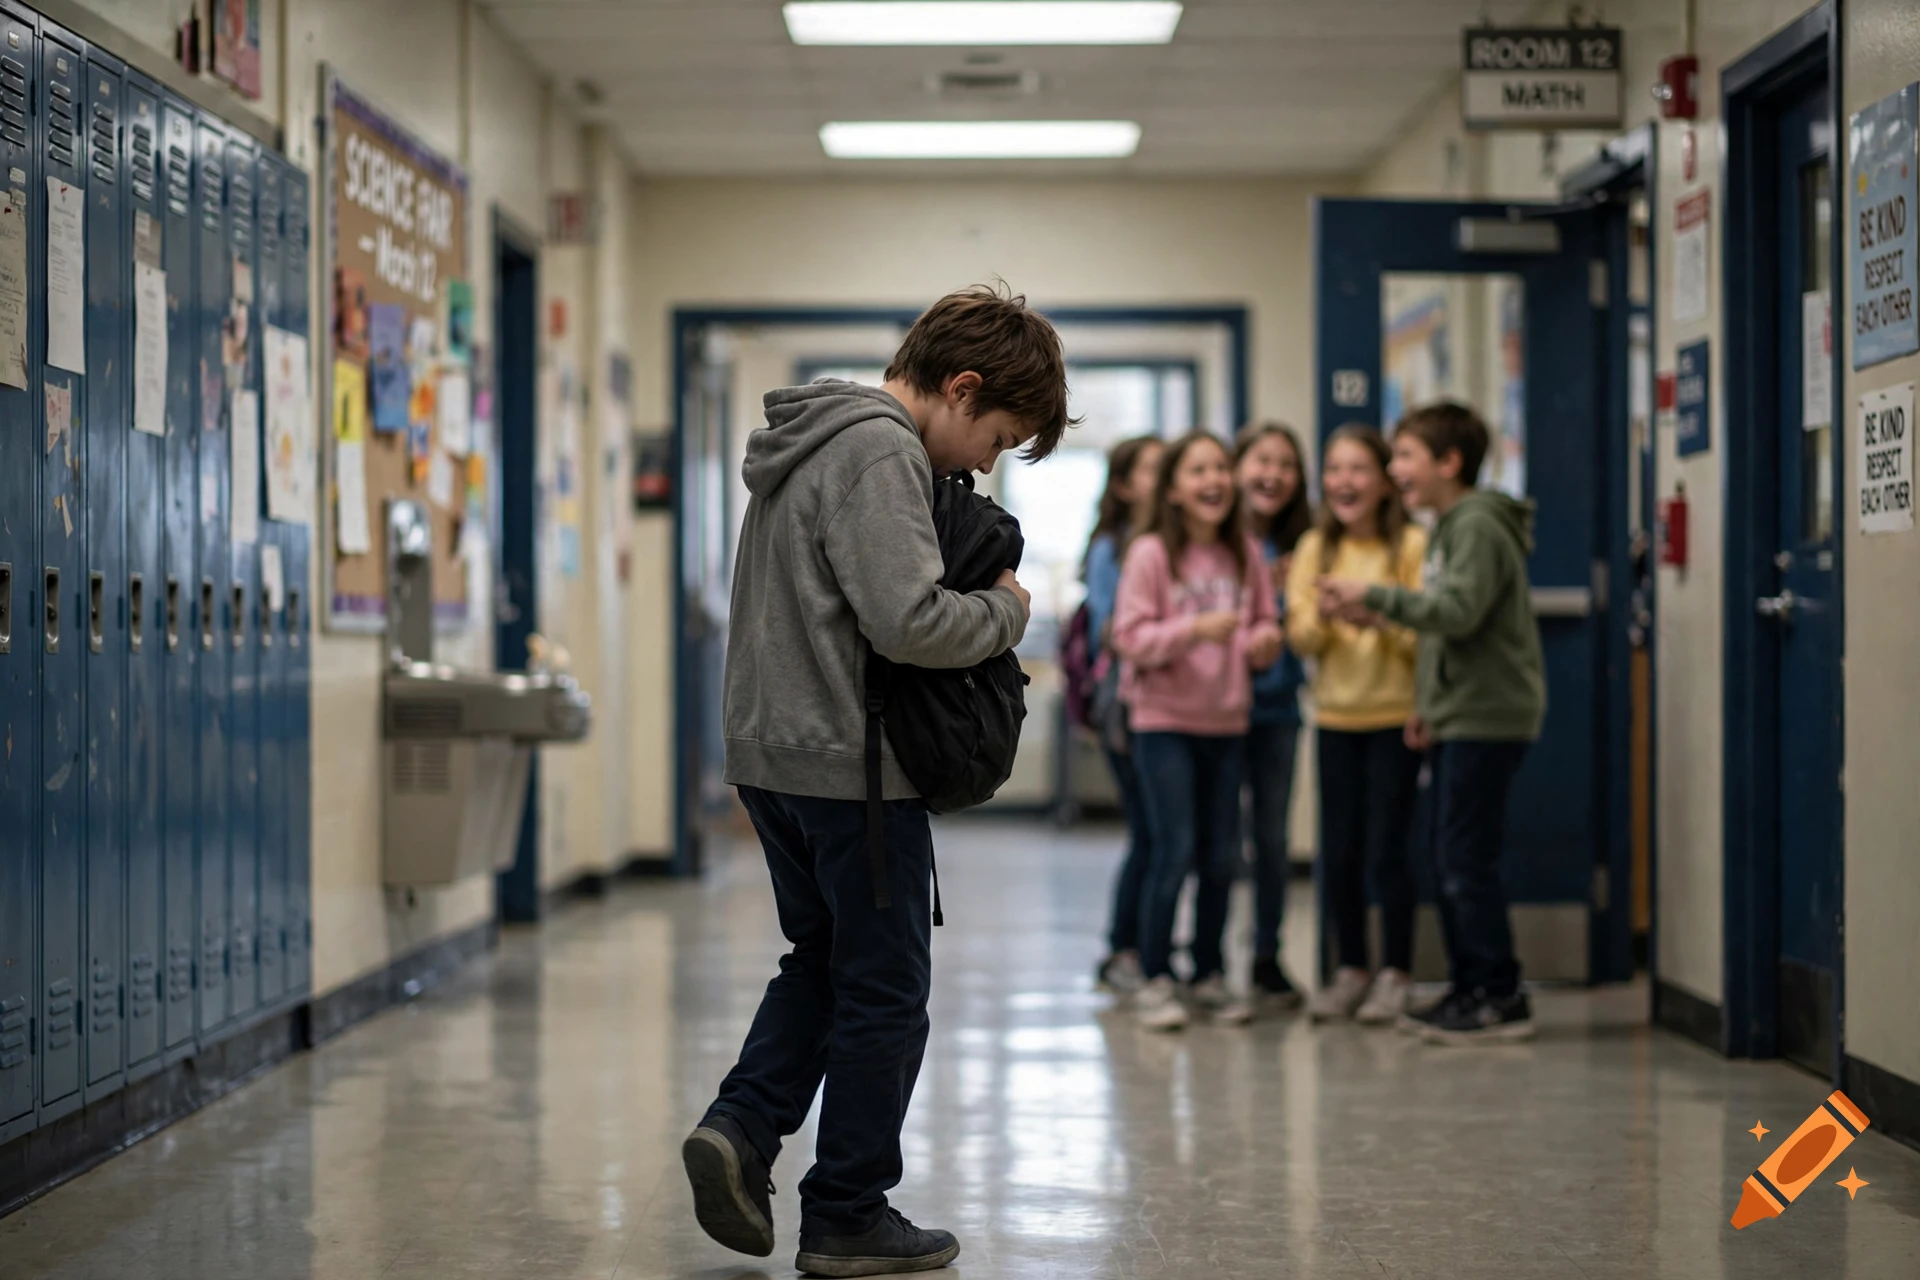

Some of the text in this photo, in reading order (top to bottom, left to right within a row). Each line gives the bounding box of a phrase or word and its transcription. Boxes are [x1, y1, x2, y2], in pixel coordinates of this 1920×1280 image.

[1471, 37, 1614, 69] ROOM 12
[1502, 80, 1587, 110] MATH
[344, 132, 415, 233] SCIENCE
[1859, 194, 1906, 250] BE KIND
[1864, 249, 1904, 291] RESPECT
[1856, 287, 1912, 336] EACH OTHER
[1865, 405, 1905, 447] BE KIND
[1867, 447, 1902, 481] RESPECT
[1861, 480, 1910, 517] EACH OTHER
